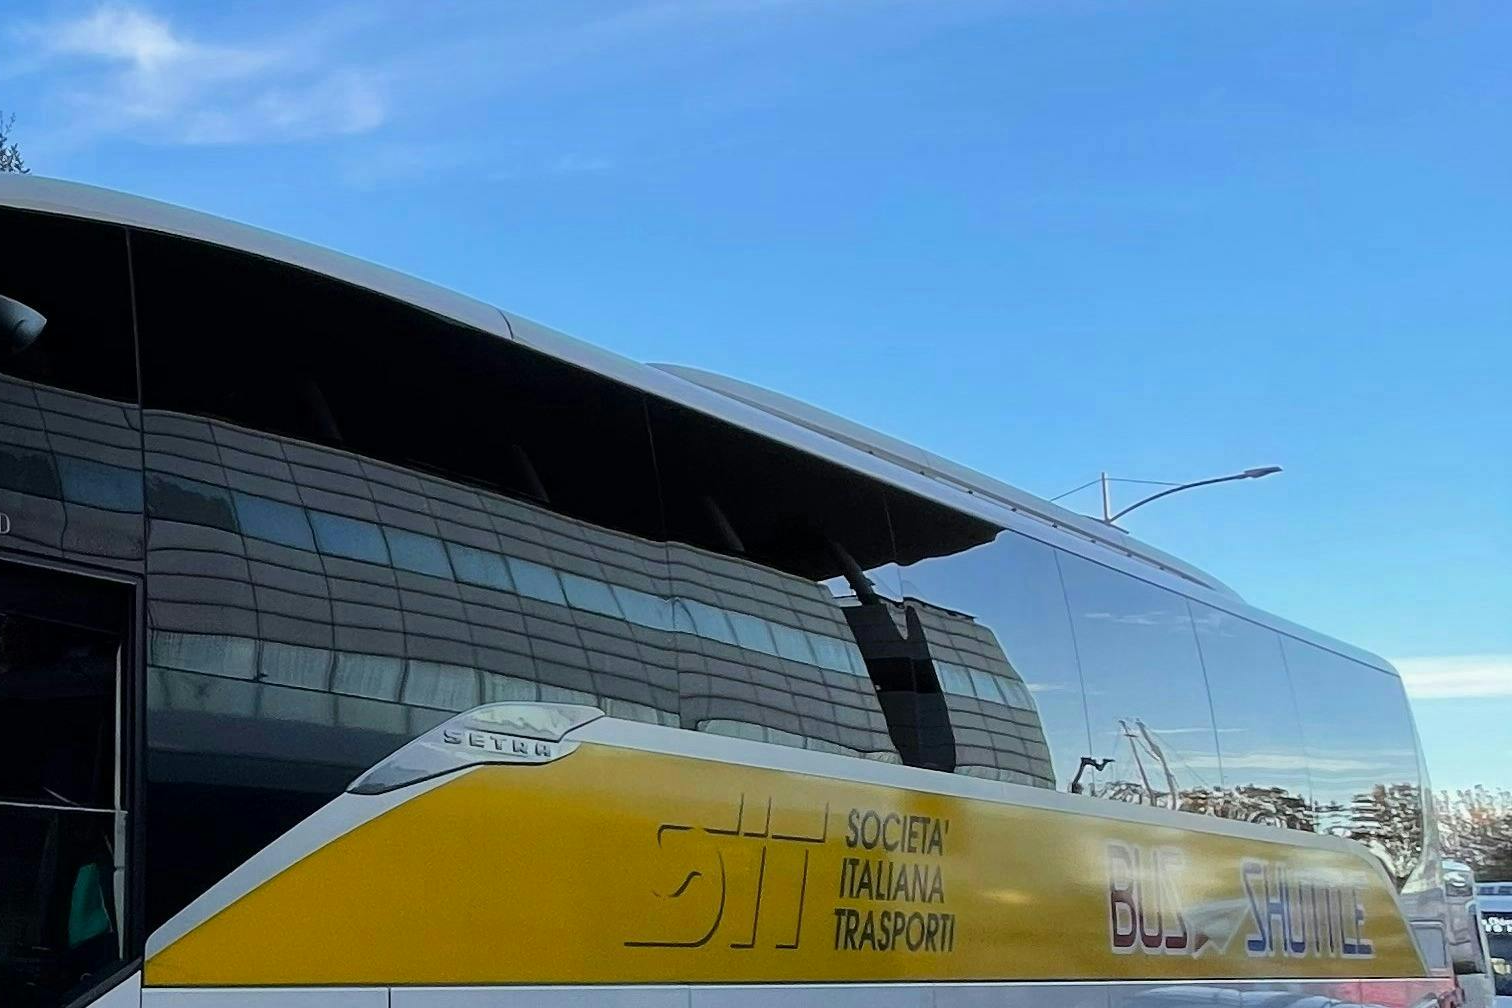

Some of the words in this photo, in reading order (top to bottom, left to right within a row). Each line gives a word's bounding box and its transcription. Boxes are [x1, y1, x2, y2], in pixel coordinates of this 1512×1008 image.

[443, 729, 551, 758] SETRA
[838, 857, 945, 904] ITALIANA
[1106, 842, 1190, 955] BUS
[1239, 857, 1376, 959] SHUTTLE
[833, 907, 956, 953] TRASPORTI
